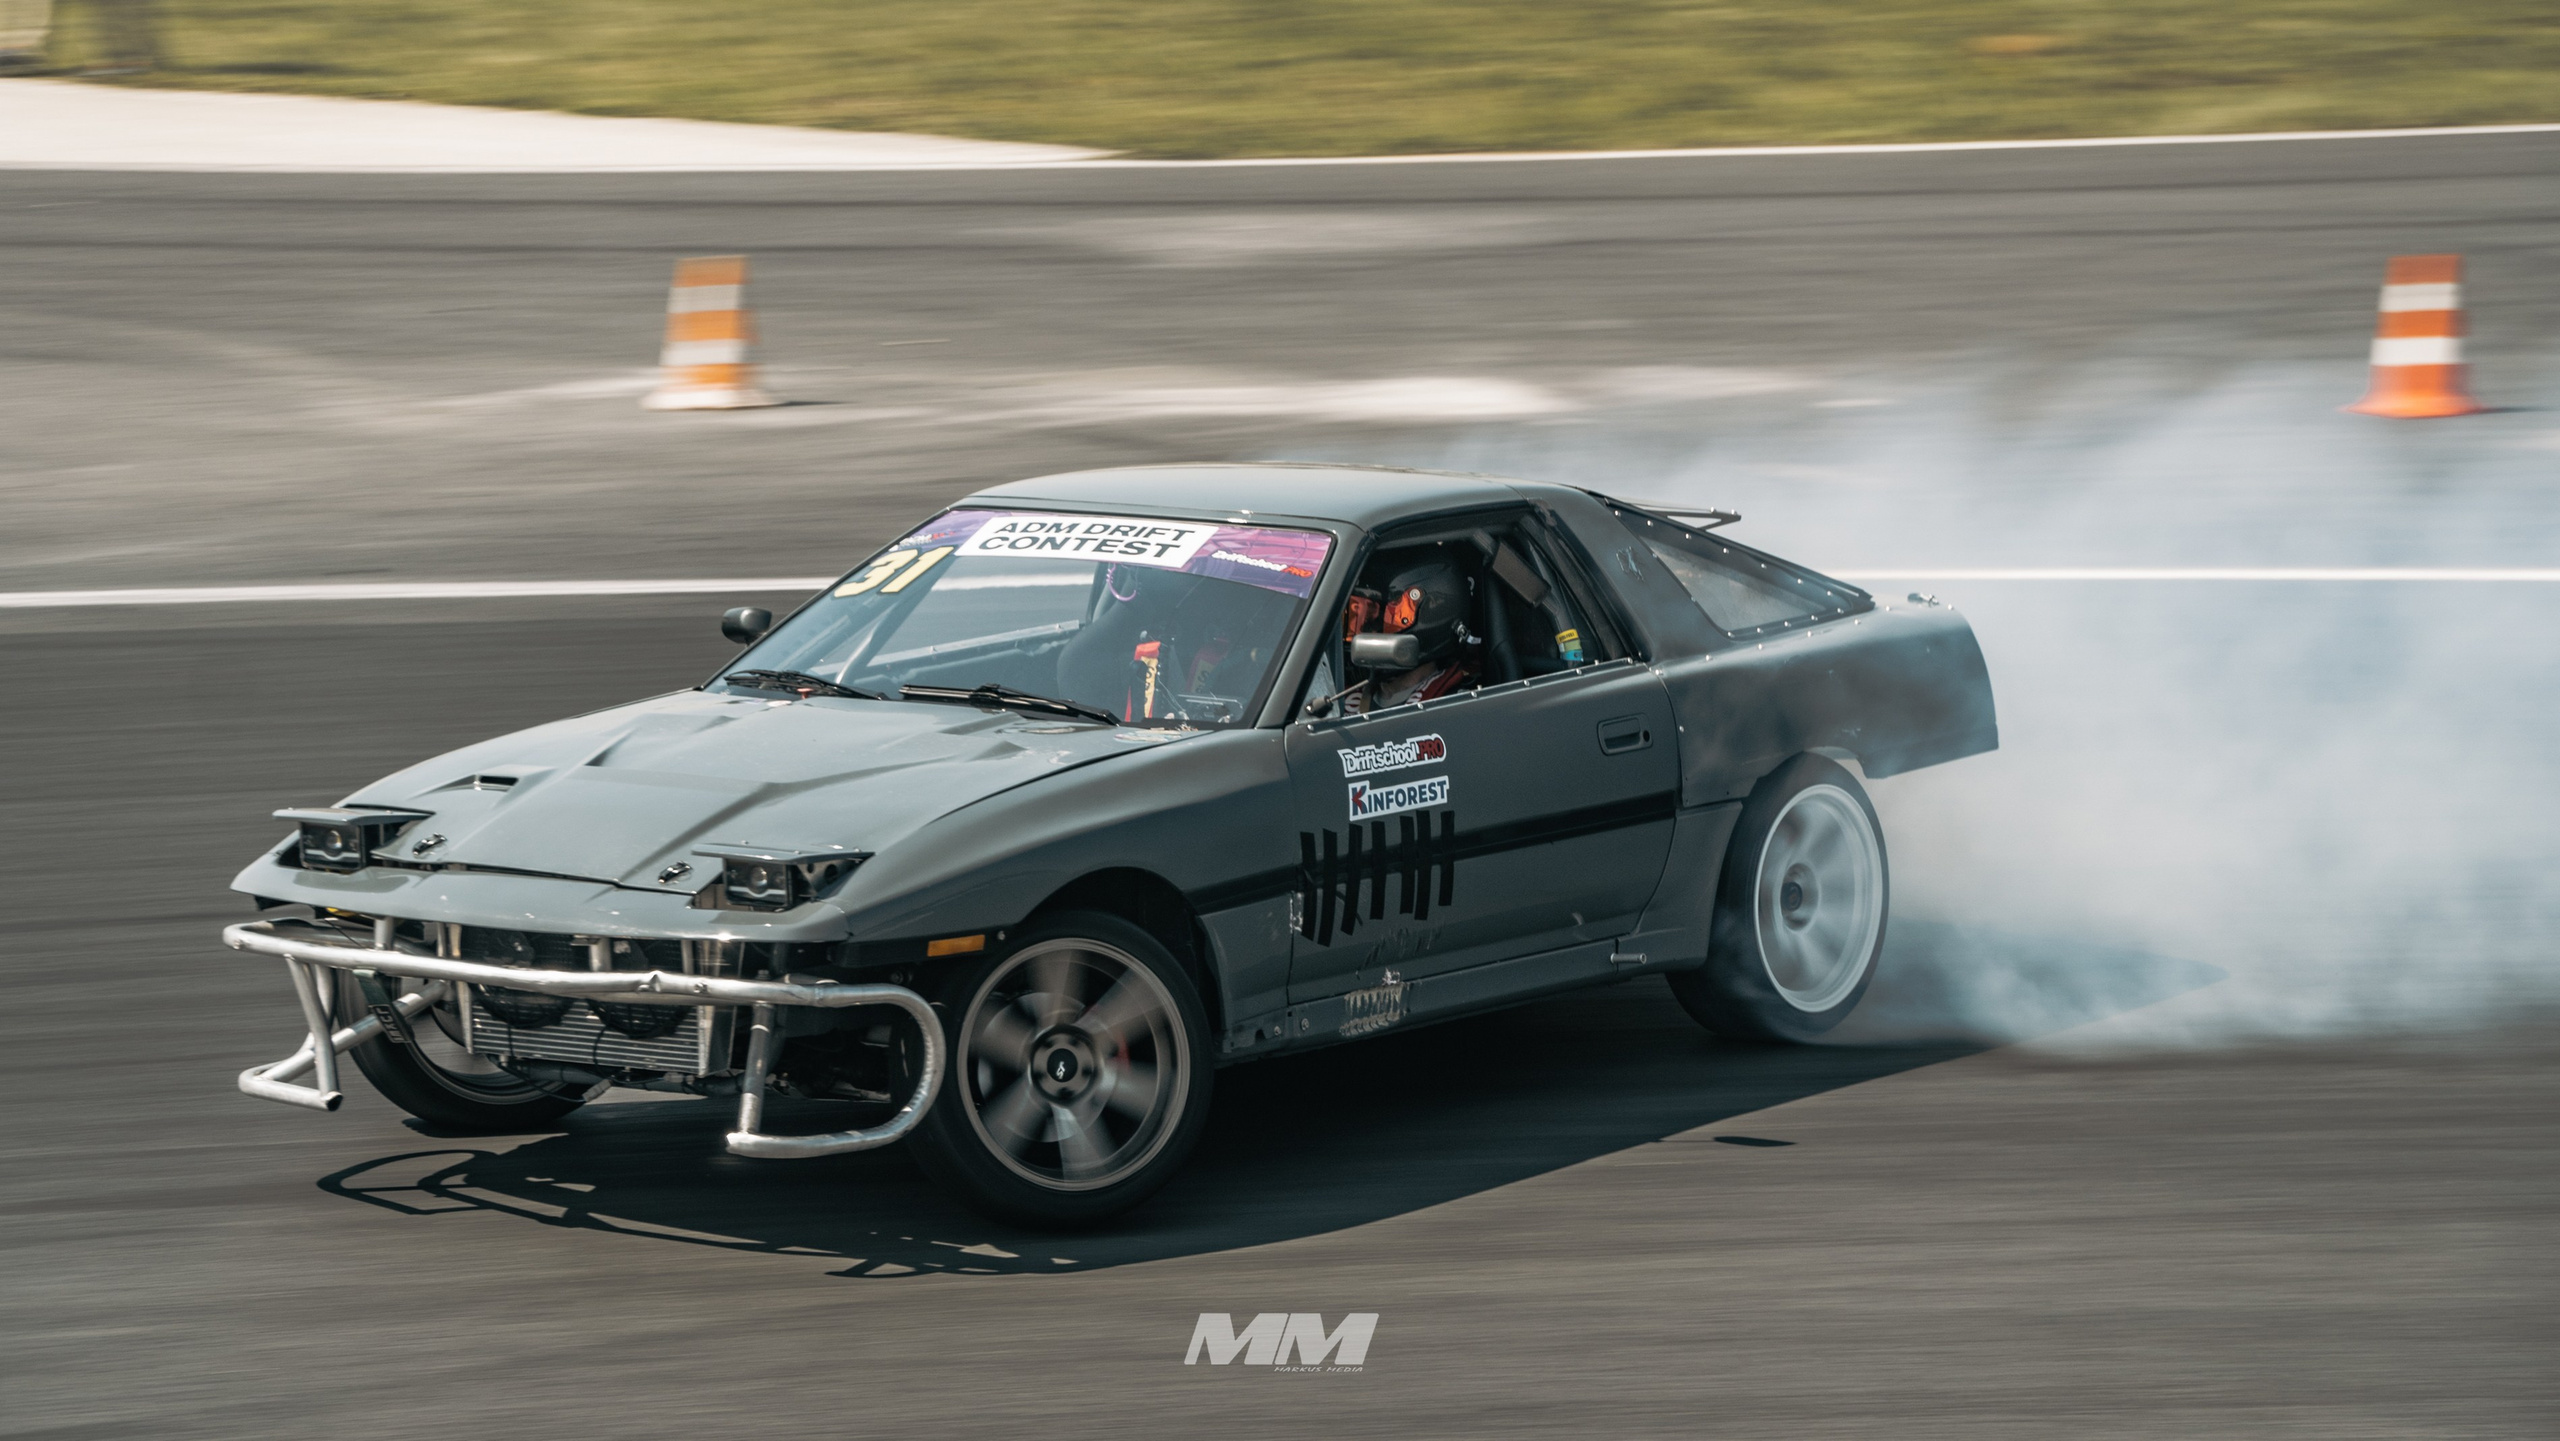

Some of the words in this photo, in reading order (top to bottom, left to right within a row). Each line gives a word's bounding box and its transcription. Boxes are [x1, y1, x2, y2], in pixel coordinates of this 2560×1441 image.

[995, 522, 1079, 534] ADM
[1082, 523, 1195, 542] DRIFT
[979, 536, 1181, 558] CONTEST
[833, 545, 955, 598] 31
[1351, 780, 1447, 816] KINFOREST
